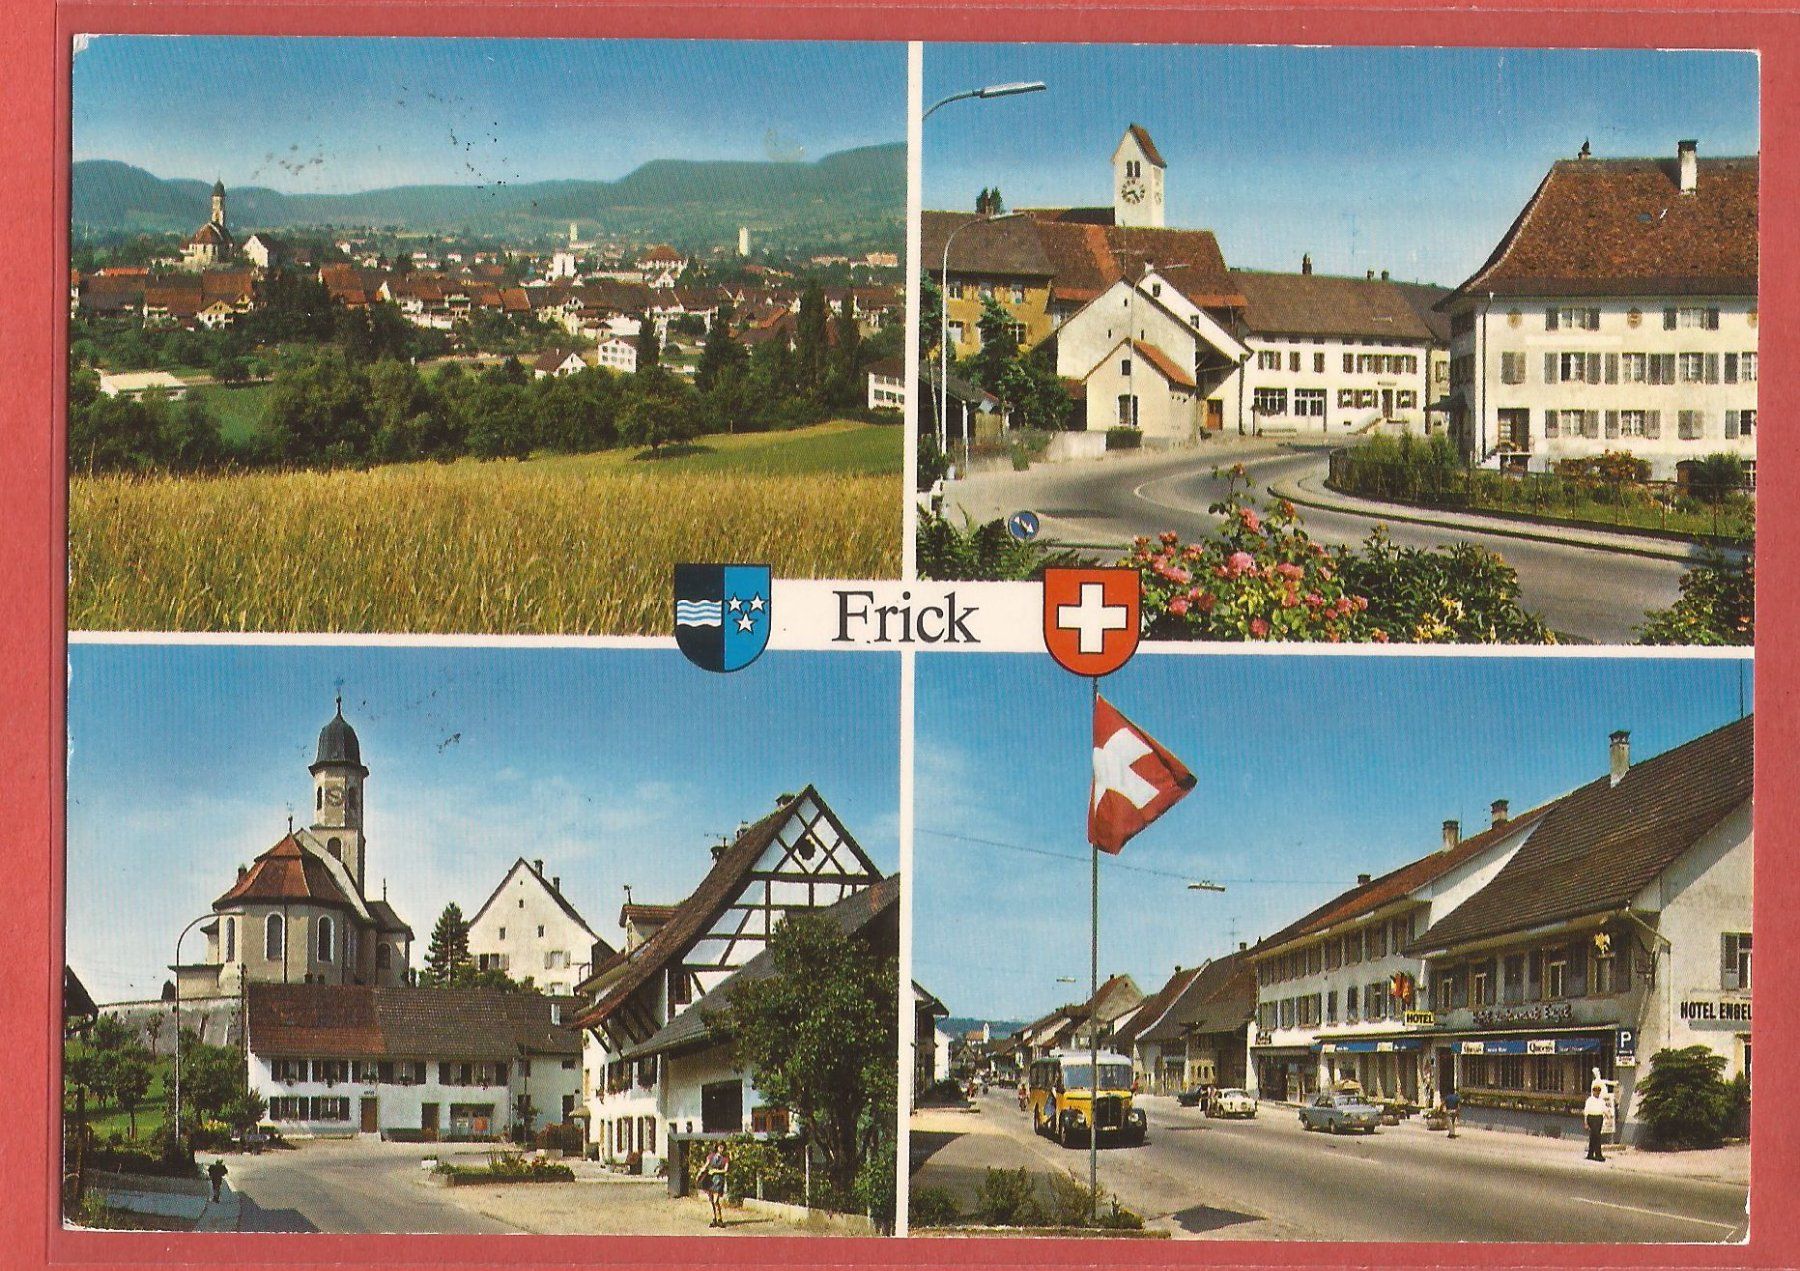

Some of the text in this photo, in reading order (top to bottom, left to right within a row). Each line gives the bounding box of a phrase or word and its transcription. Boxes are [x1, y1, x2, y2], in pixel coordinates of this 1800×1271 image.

[1406, 1013, 1434, 1024] HOTEL
[1680, 1001, 1752, 1020] HOTEL ENGEL
[1620, 1031, 1632, 1048] P
